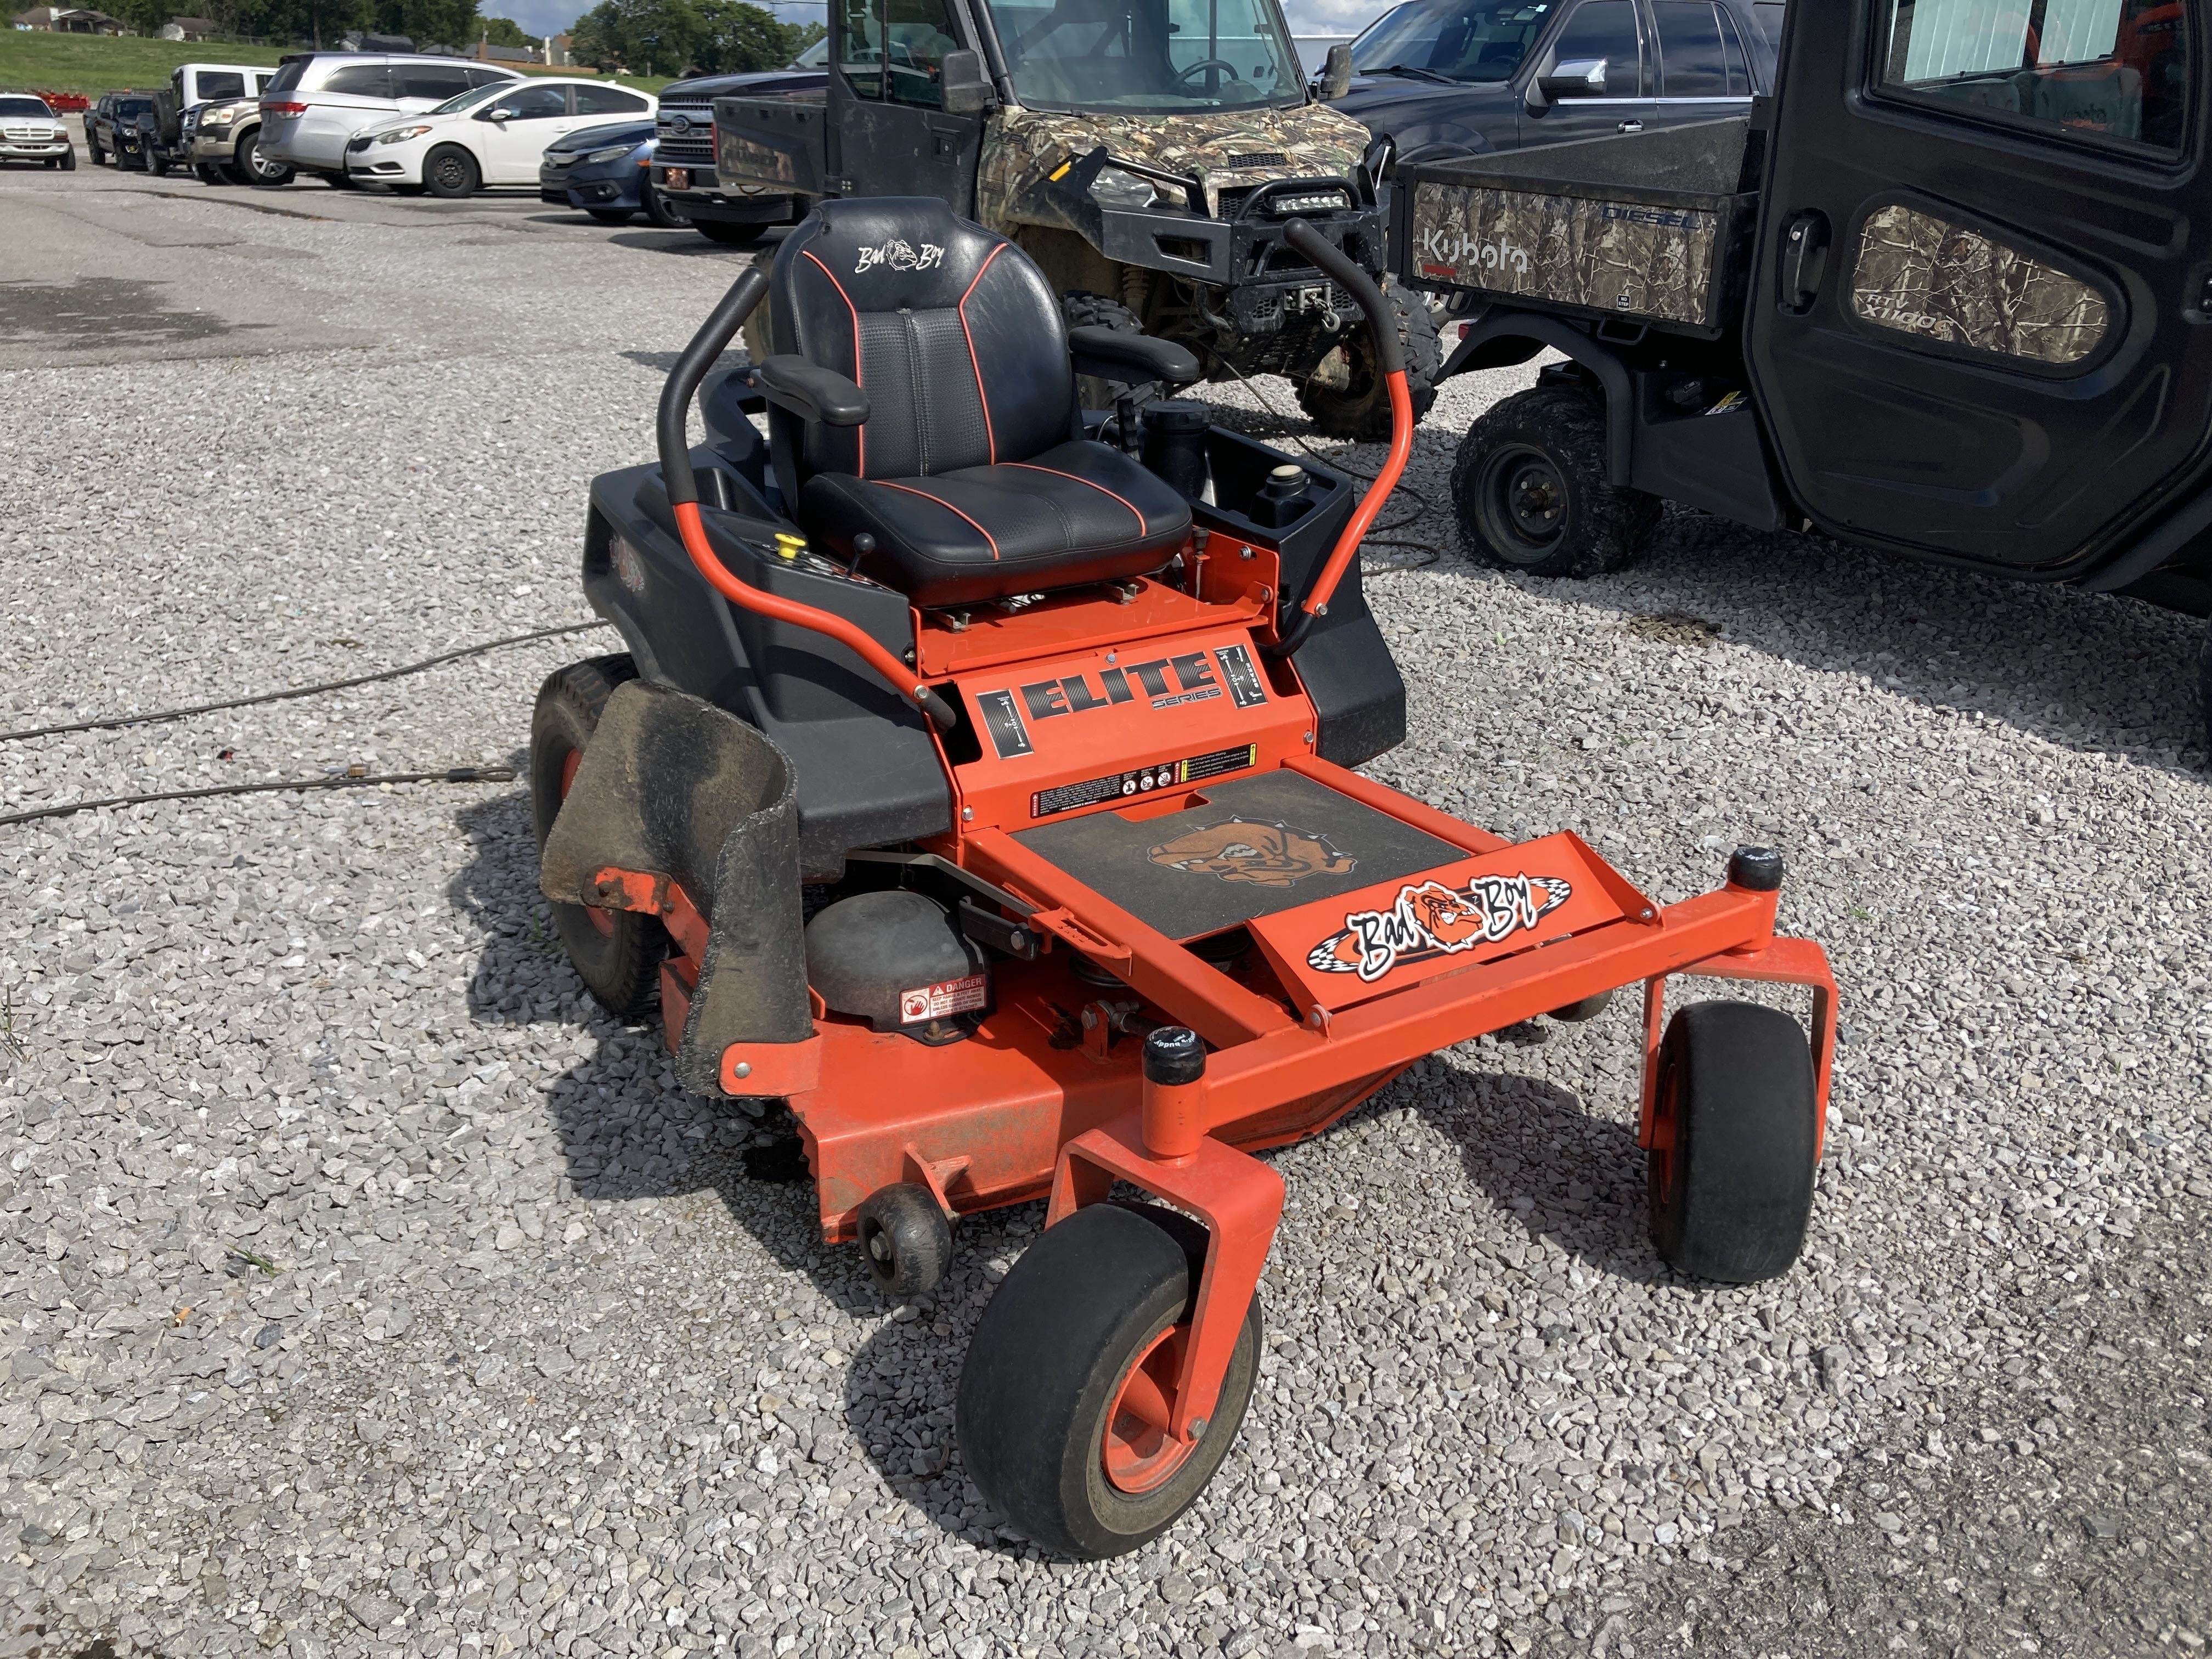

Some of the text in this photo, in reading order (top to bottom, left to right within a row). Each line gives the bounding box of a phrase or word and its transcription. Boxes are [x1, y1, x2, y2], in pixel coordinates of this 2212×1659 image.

[1602, 207, 1699, 229] DIESEL
[916, 244, 945, 270] Boy
[1424, 228, 1528, 273] Kubota
[1866, 294, 1909, 309] RTV
[1020, 651, 1217, 720] ELITE
[1152, 687, 1222, 710] SERIES
[1351, 876, 1534, 976] Bad Boy
[946, 978, 981, 992] DANGER
[1154, 1039, 1181, 1048] buddy
